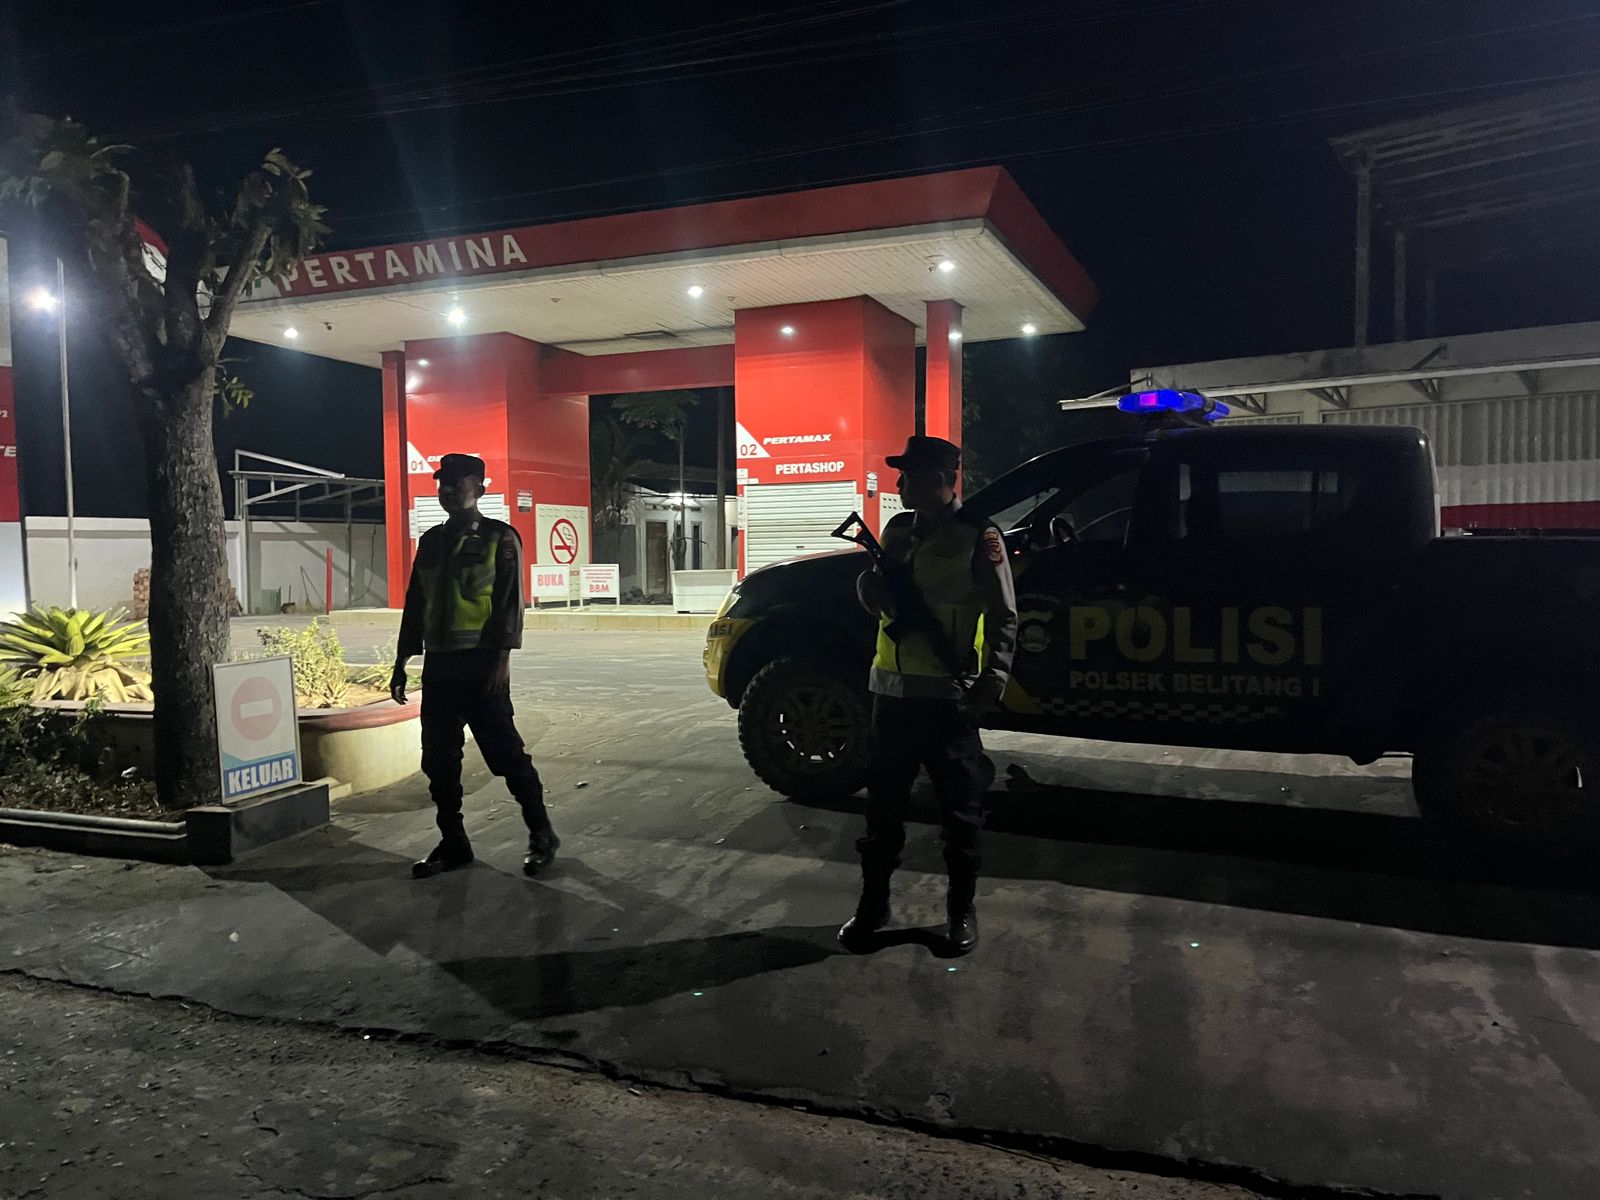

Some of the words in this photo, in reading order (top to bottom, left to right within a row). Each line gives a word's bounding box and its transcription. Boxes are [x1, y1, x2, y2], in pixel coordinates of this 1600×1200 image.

[277, 234, 528, 291] PERTAMINA
[763, 433, 832, 445] PERTAMAX
[740, 444, 757, 456] 02
[410, 460, 424, 471] 01
[775, 461, 845, 475] PERTASHOP
[537, 574, 564, 587] BUKA
[589, 584, 609, 593] BBM
[1069, 605, 1323, 665] POLISI
[1070, 671, 1165, 691] POLSEK
[1172, 673, 1302, 697] BELITANG
[228, 758, 293, 794] KELUAR
